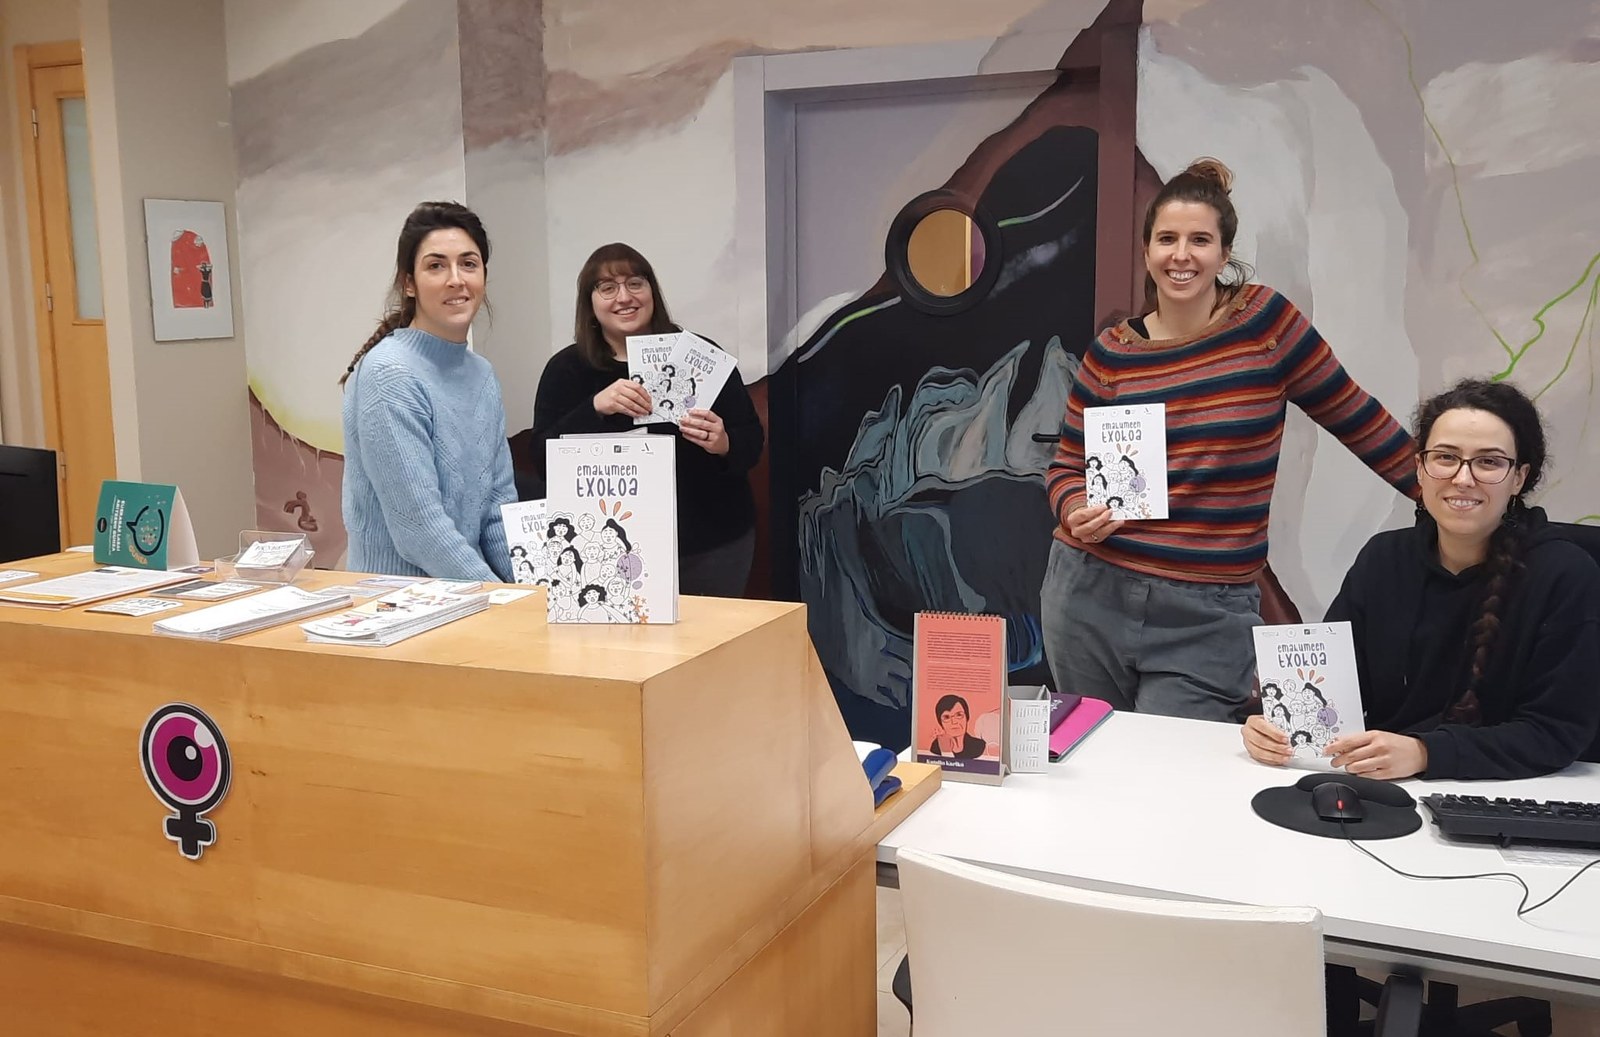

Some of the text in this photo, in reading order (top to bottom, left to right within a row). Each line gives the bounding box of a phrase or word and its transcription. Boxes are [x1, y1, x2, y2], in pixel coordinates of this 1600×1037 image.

[1101, 421, 1142, 431] emakumeen
[1101, 429, 1142, 443] txokoa
[577, 464, 638, 477] emakumeen
[576, 477, 638, 497] txokoa
[1277, 642, 1326, 653] emakumeen
[1278, 652, 1327, 668] txokoa
